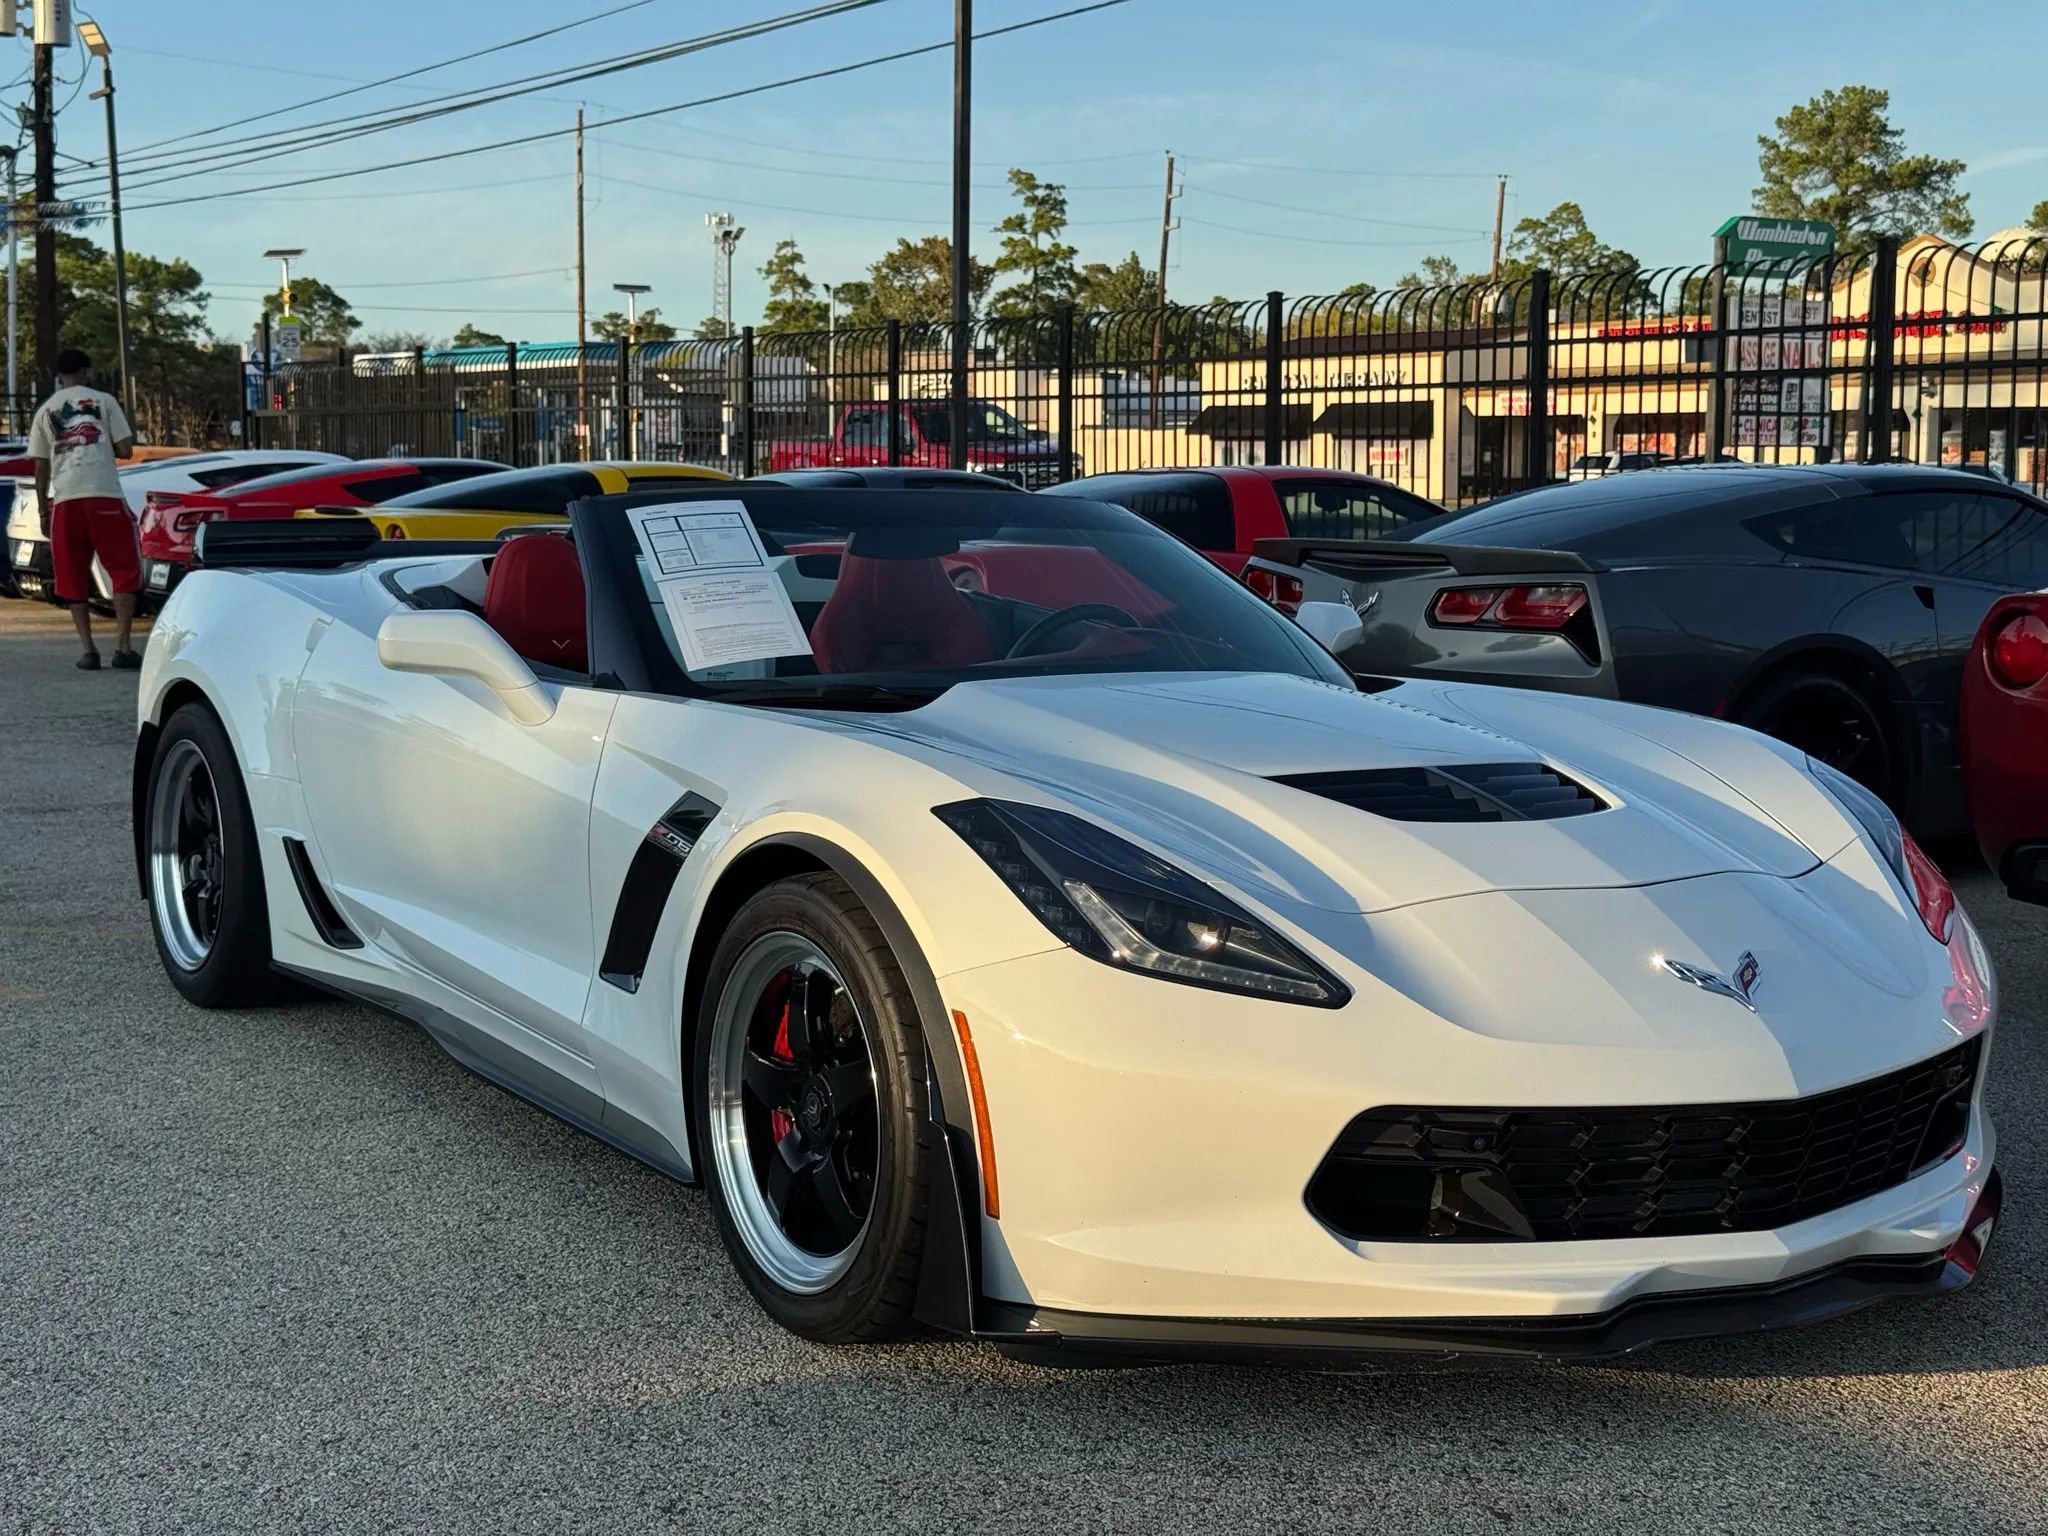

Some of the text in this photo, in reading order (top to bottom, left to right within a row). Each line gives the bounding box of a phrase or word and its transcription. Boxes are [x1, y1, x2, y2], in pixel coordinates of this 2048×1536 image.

[1736, 220, 1828, 245] Wimbledon
[1738, 310, 1778, 324] ENIST
[282, 337, 300, 347] 25
[1734, 342, 1777, 368] ASSGE
[1782, 341, 1824, 368] NALS
[1744, 418, 1779, 432] CLNICA
